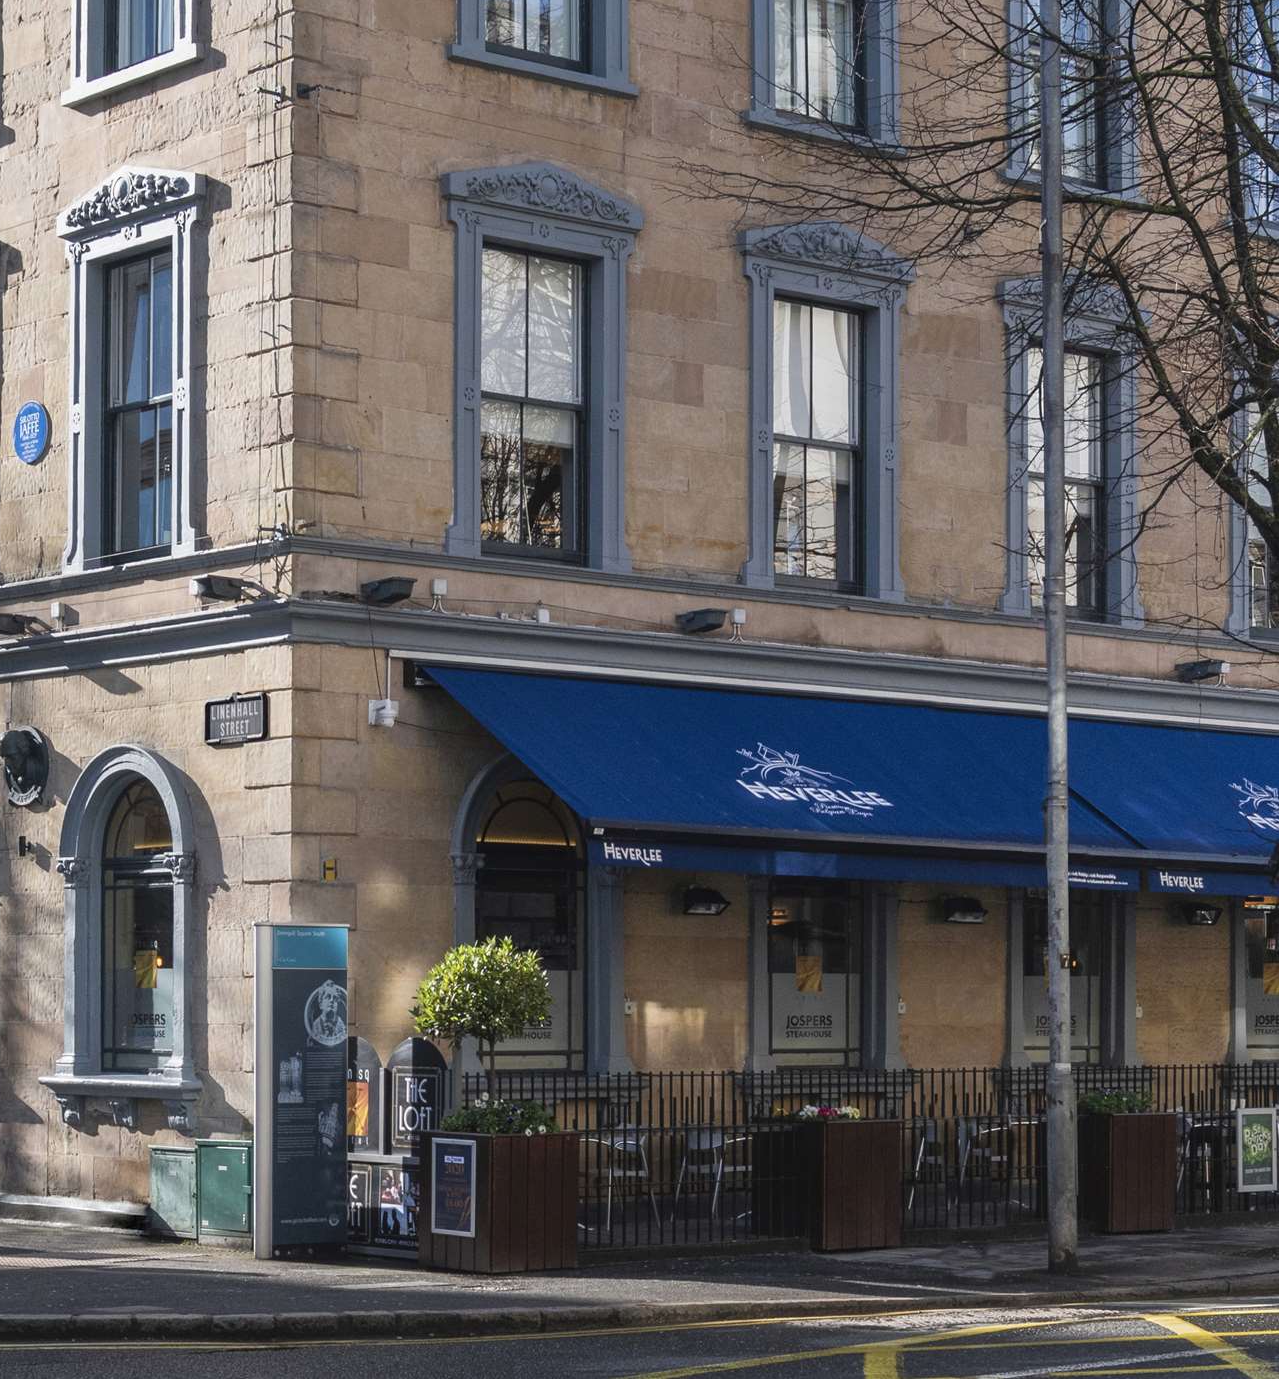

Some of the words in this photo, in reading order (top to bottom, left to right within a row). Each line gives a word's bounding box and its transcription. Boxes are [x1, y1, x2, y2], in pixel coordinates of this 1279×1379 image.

[211, 700, 259, 720] LINENHALL
[220, 720, 249, 737] STREET
[735, 779, 895, 810] HEVERLEE
[603, 842, 664, 867] HEVERLEE
[1159, 871, 1205, 892] HEVERLEE
[785, 1015, 833, 1029] JOSPERS
[784, 1030, 832, 1038] STEAKHOUSE
[358, 1069, 370, 1083] sq
[404, 1077, 428, 1104] THE
[399, 1104, 432, 1132] LOFT
